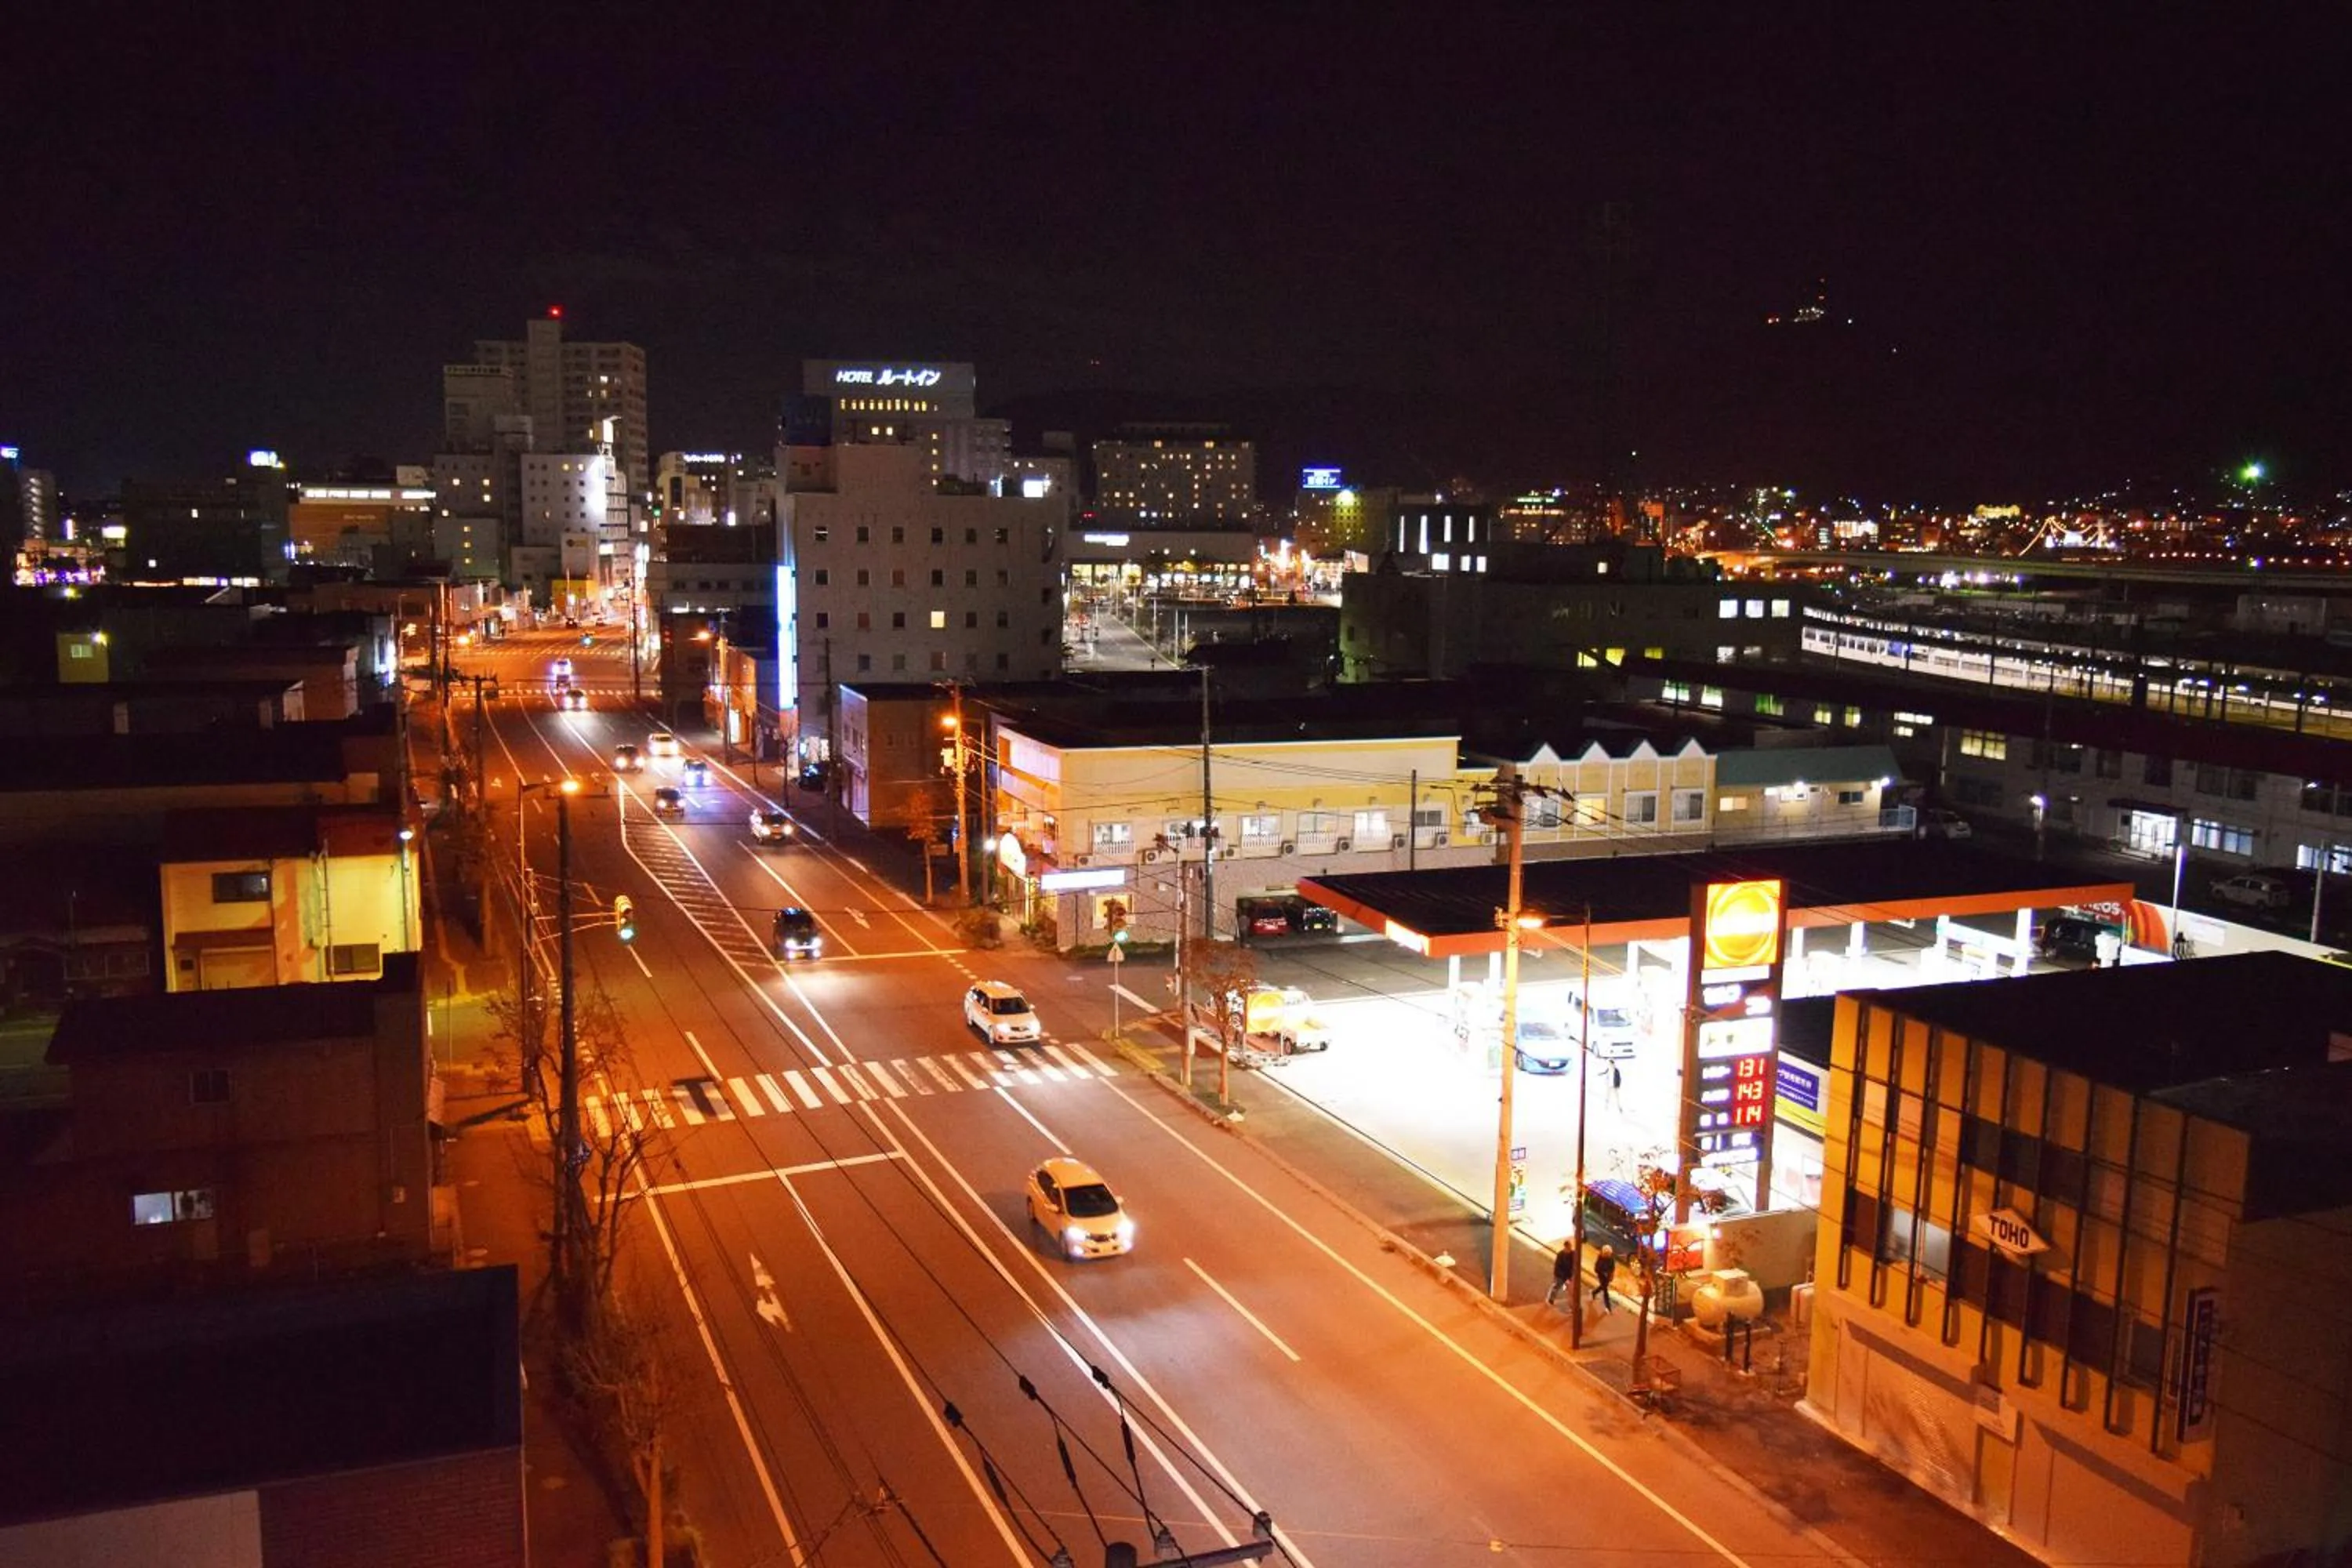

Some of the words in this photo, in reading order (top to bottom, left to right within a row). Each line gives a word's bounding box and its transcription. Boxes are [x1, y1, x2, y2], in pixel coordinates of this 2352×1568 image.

[837, 370, 873, 383] HOTEL
[877, 368, 941, 386] ルートイン
[1738, 1058, 1765, 1077] 131
[1737, 1081, 1763, 1101] 143
[1736, 1105, 1762, 1124] 114
[1988, 1214, 2029, 1248] TOHO
